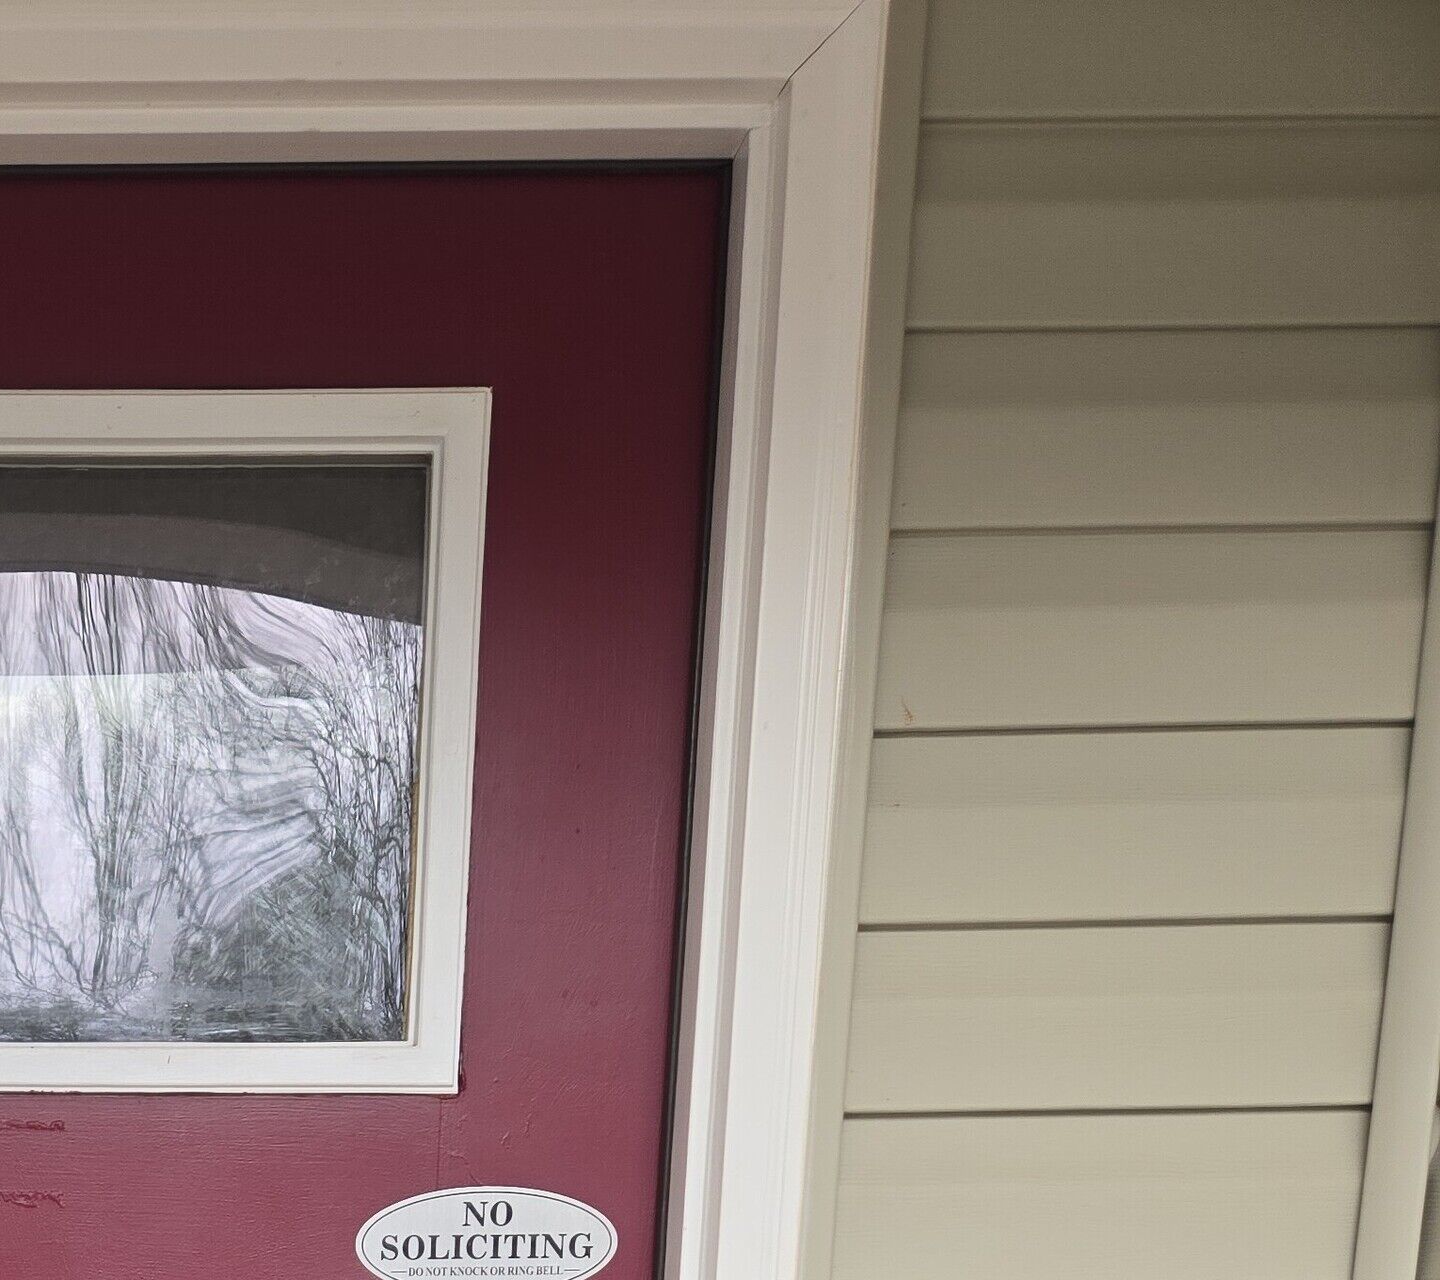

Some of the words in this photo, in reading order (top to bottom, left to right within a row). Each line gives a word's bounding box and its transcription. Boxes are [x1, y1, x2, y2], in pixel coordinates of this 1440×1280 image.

[462, 1200, 514, 1227] NO
[380, 1232, 594, 1261] SOLICITING
[408, 1266, 424, 1277] DO
[426, 1266, 448, 1276] NOT
[450, 1265, 488, 1276] KNOCK
[490, 1265, 505, 1275] OR
[507, 1265, 534, 1275] RING
[536, 1265, 564, 1275] BELL
